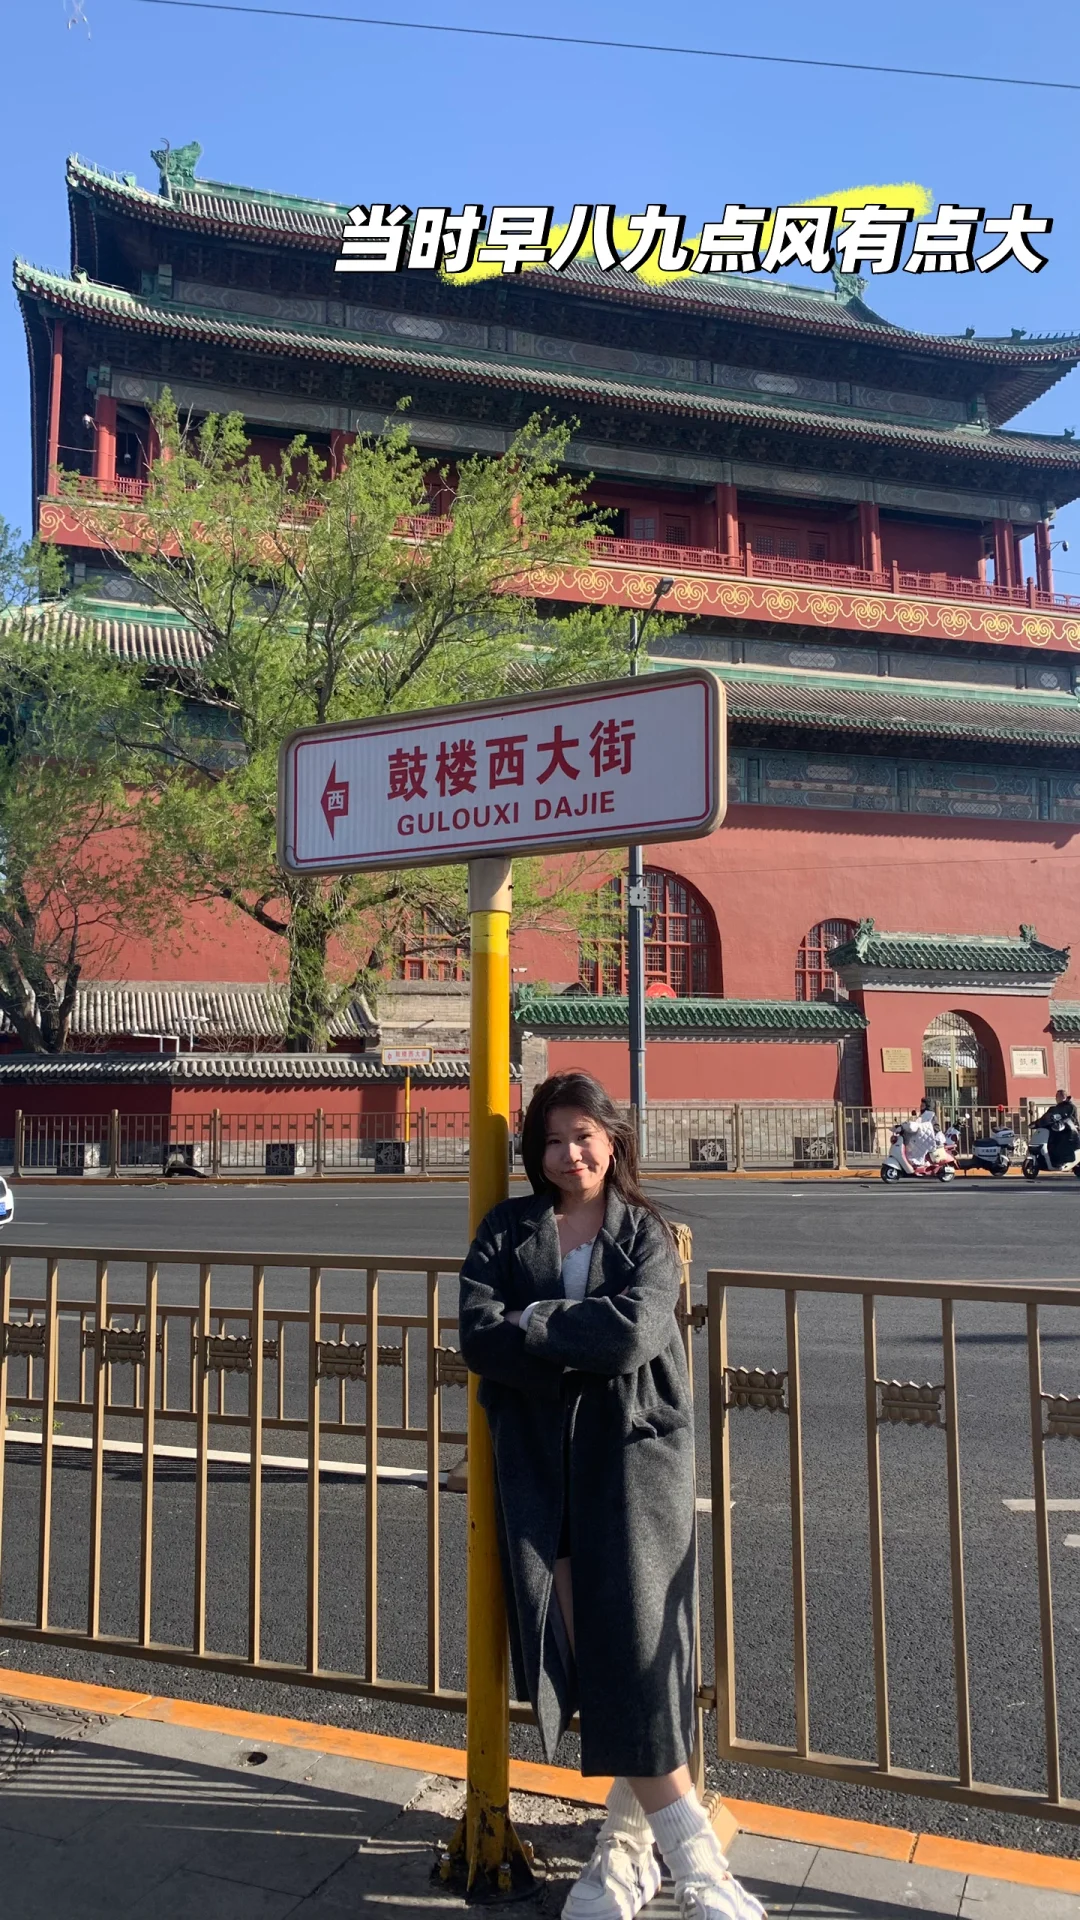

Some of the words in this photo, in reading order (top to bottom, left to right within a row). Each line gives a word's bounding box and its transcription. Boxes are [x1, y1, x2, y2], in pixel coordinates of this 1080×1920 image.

[387, 718, 637, 802] 鼓楼西大街
[328, 789, 346, 811] 西
[397, 802, 520, 835] GULOUXI
[534, 790, 615, 822] DAJIE
